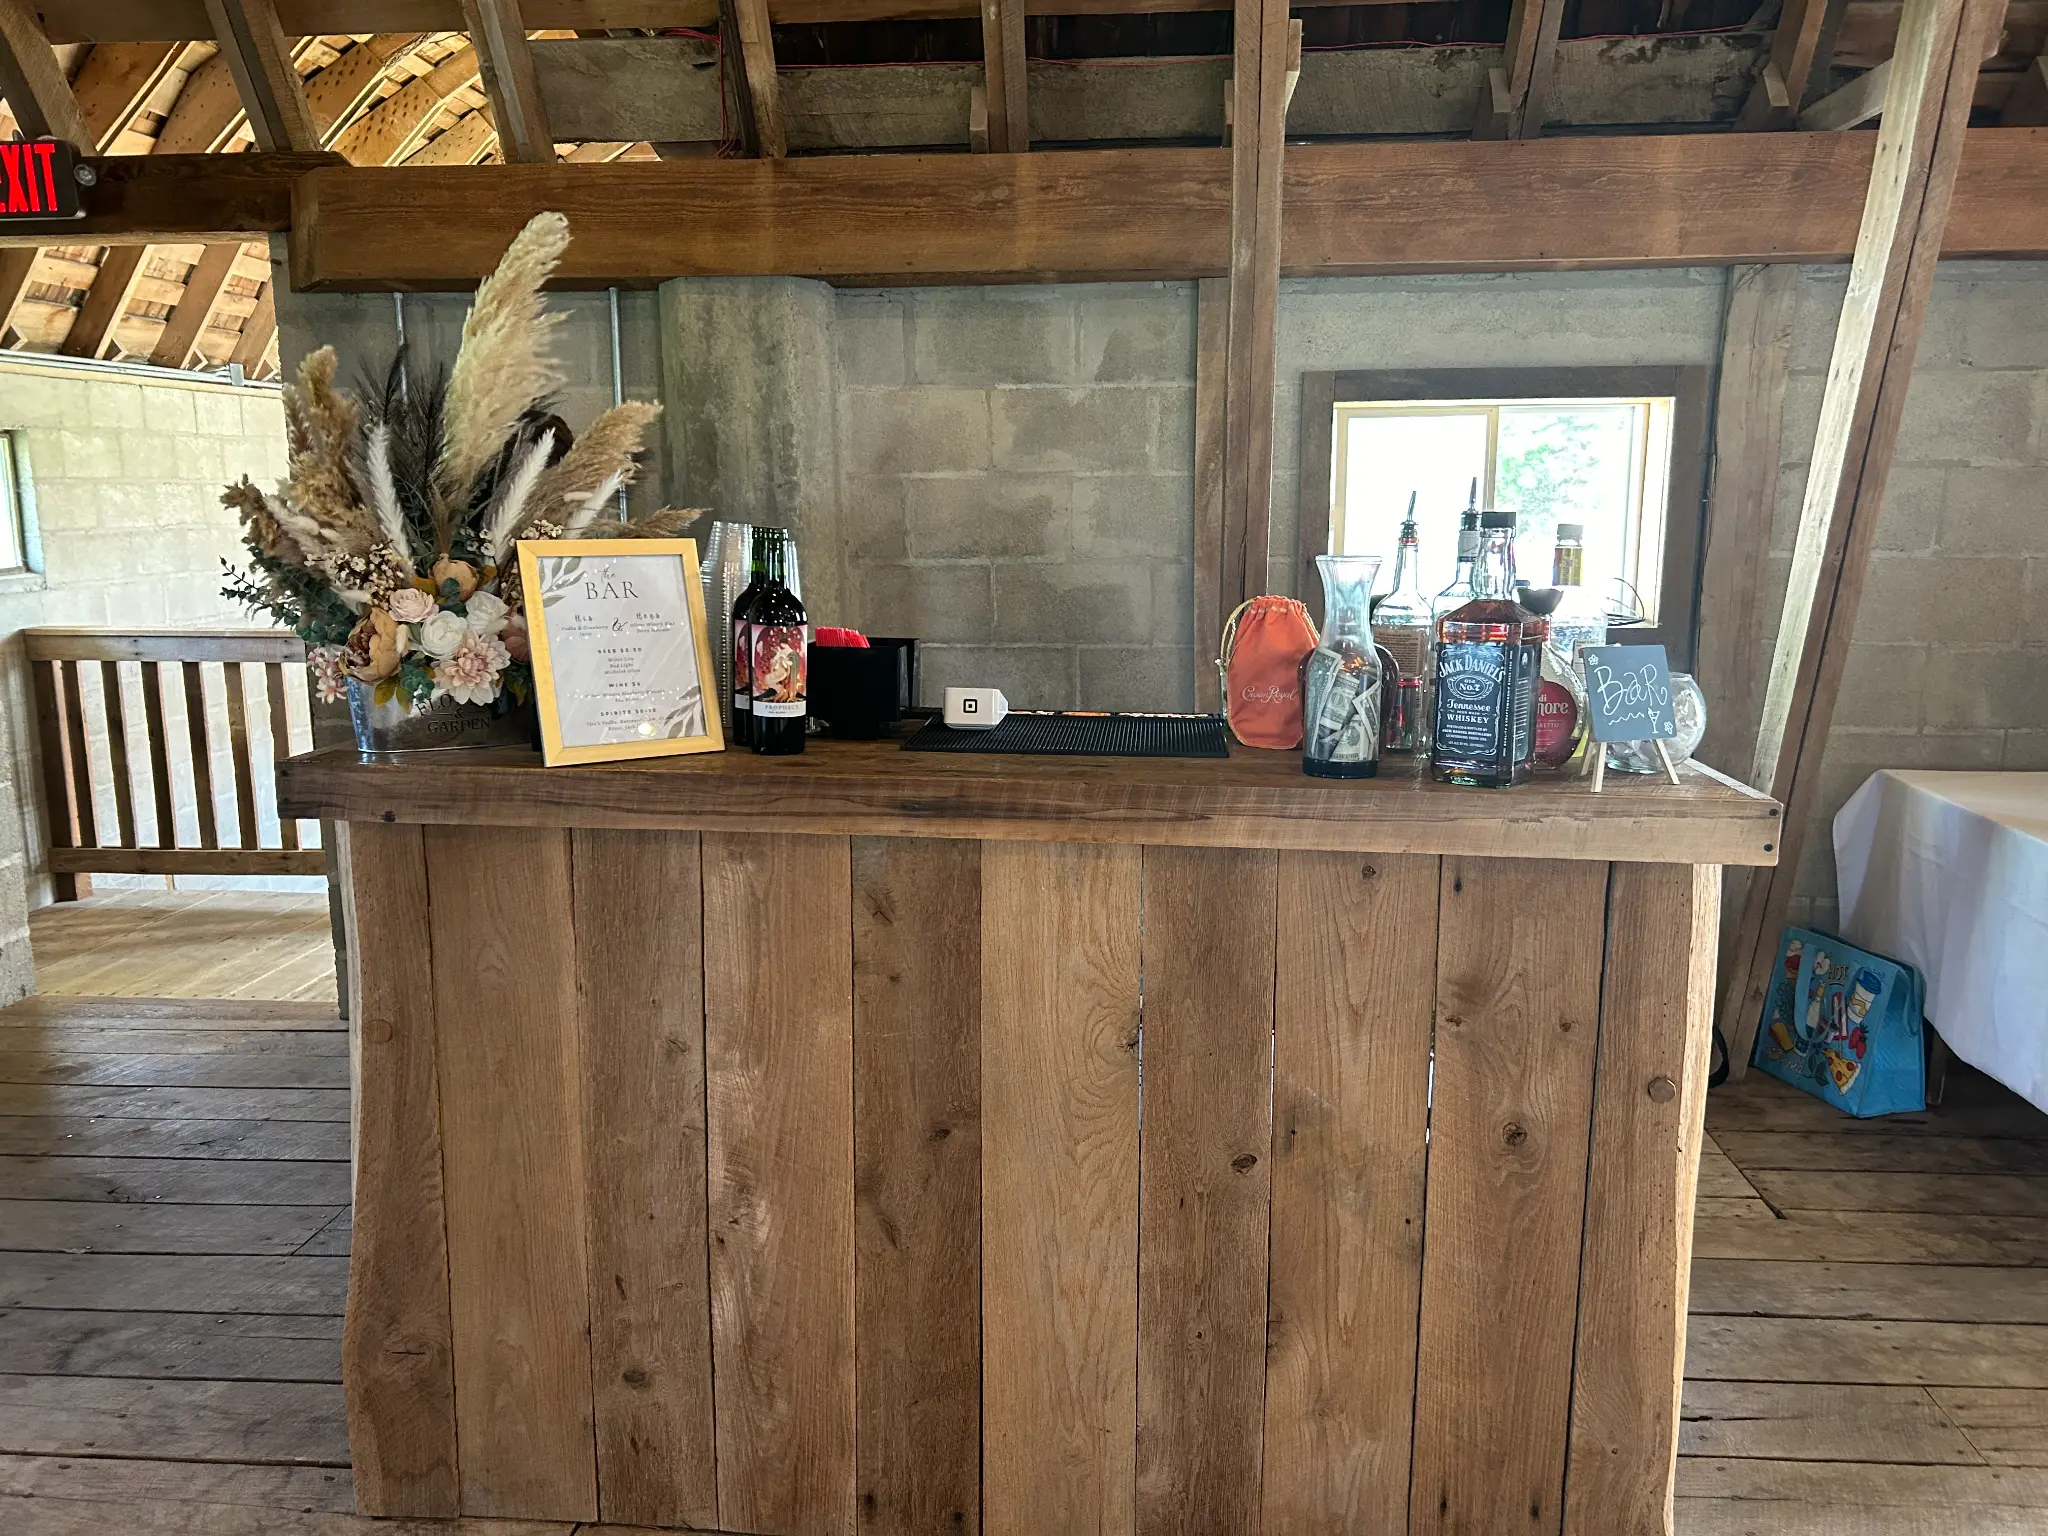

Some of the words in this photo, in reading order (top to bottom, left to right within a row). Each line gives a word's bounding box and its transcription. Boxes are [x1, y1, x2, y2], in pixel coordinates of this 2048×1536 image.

[0, 144, 58, 212] XIT
[585, 581, 639, 600] BAR
[612, 616, 629, 632] &
[1439, 659, 1464, 678] JACK
[1260, 685, 1298, 704] Royal
[600, 709, 632, 717] SPIRITS
[1446, 698, 1491, 712] Tennessee
[427, 716, 491, 734] GARDEN
[1446, 713, 1490, 725] WHISKEY
